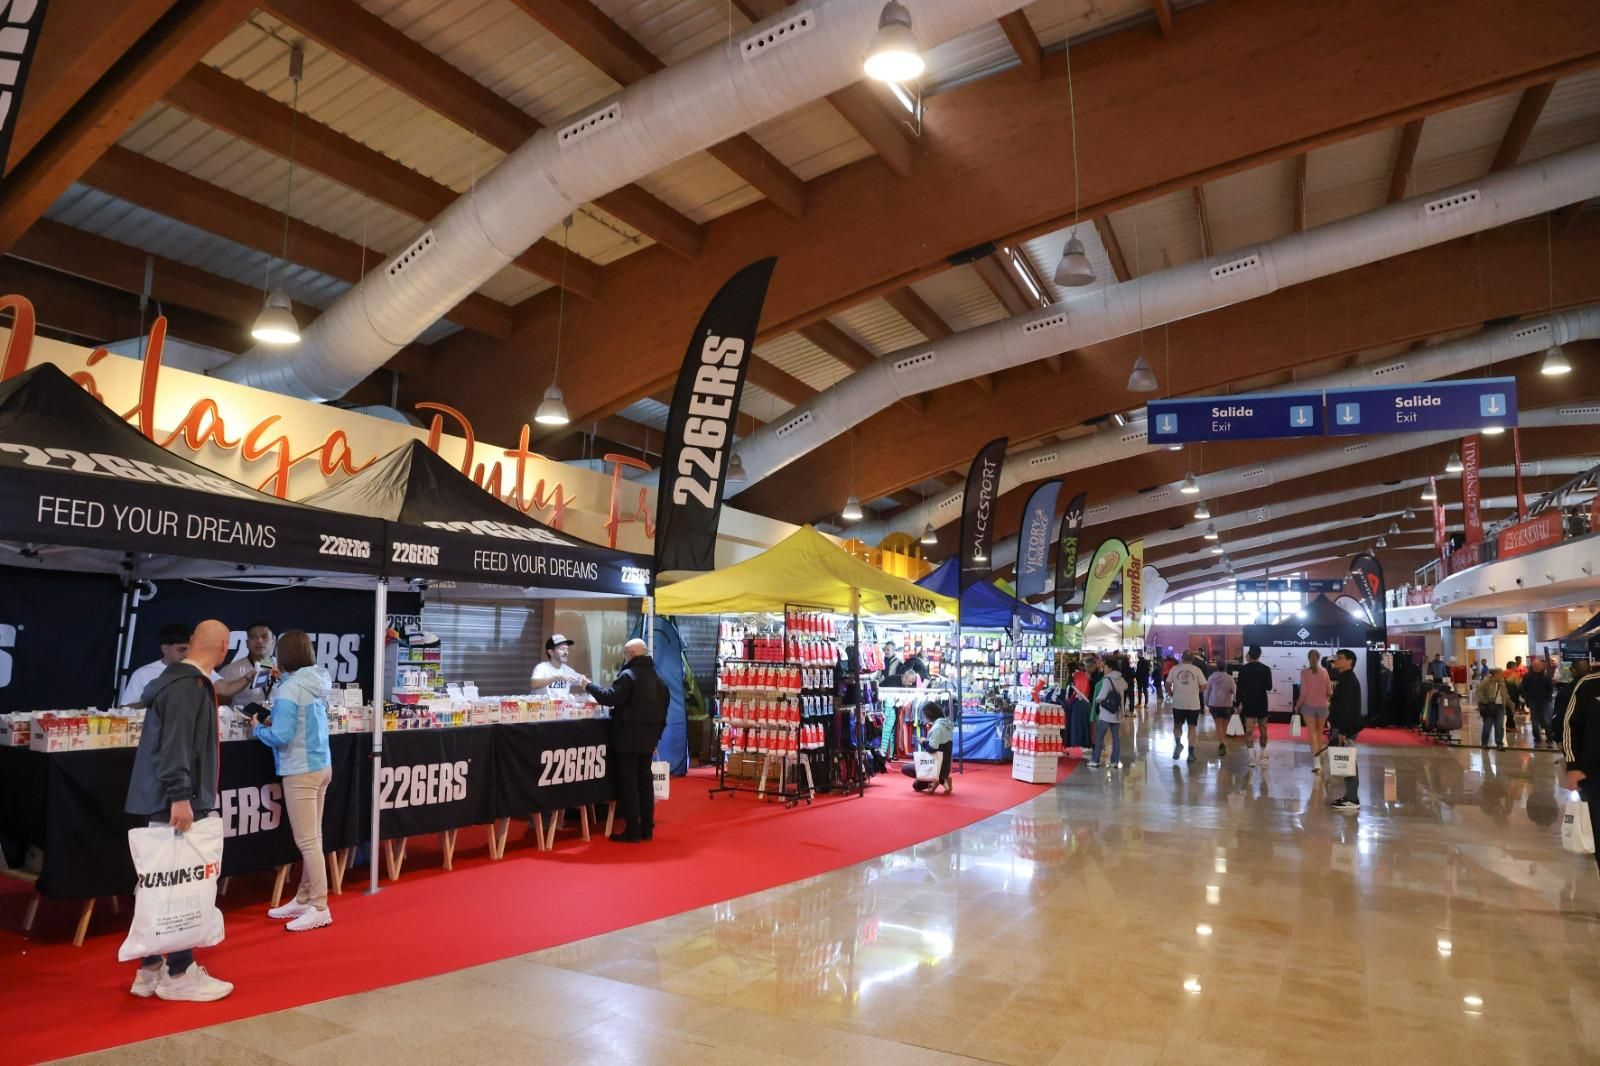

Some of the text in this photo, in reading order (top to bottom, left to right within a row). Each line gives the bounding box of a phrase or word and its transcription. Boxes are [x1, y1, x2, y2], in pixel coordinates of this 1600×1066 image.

[1212, 406, 1253, 418] Salida
[1395, 395, 1441, 408] Salida
[1396, 411, 1417, 423] Exit
[673, 334, 745, 509] 226ERS
[1212, 420, 1231, 433] Exit
[37, 495, 277, 548] FEED YOUR DREAMS
[319, 534, 371, 558] 226ERS
[392, 542, 439, 566] 226ERS
[1025, 518, 1042, 575] VICTORY
[474, 550, 598, 581] FEED YOUR DREAMS
[1127, 555, 1141, 621] PowerBar
[538, 744, 607, 787] 226ERS
[380, 761, 468, 809] 226ERS
